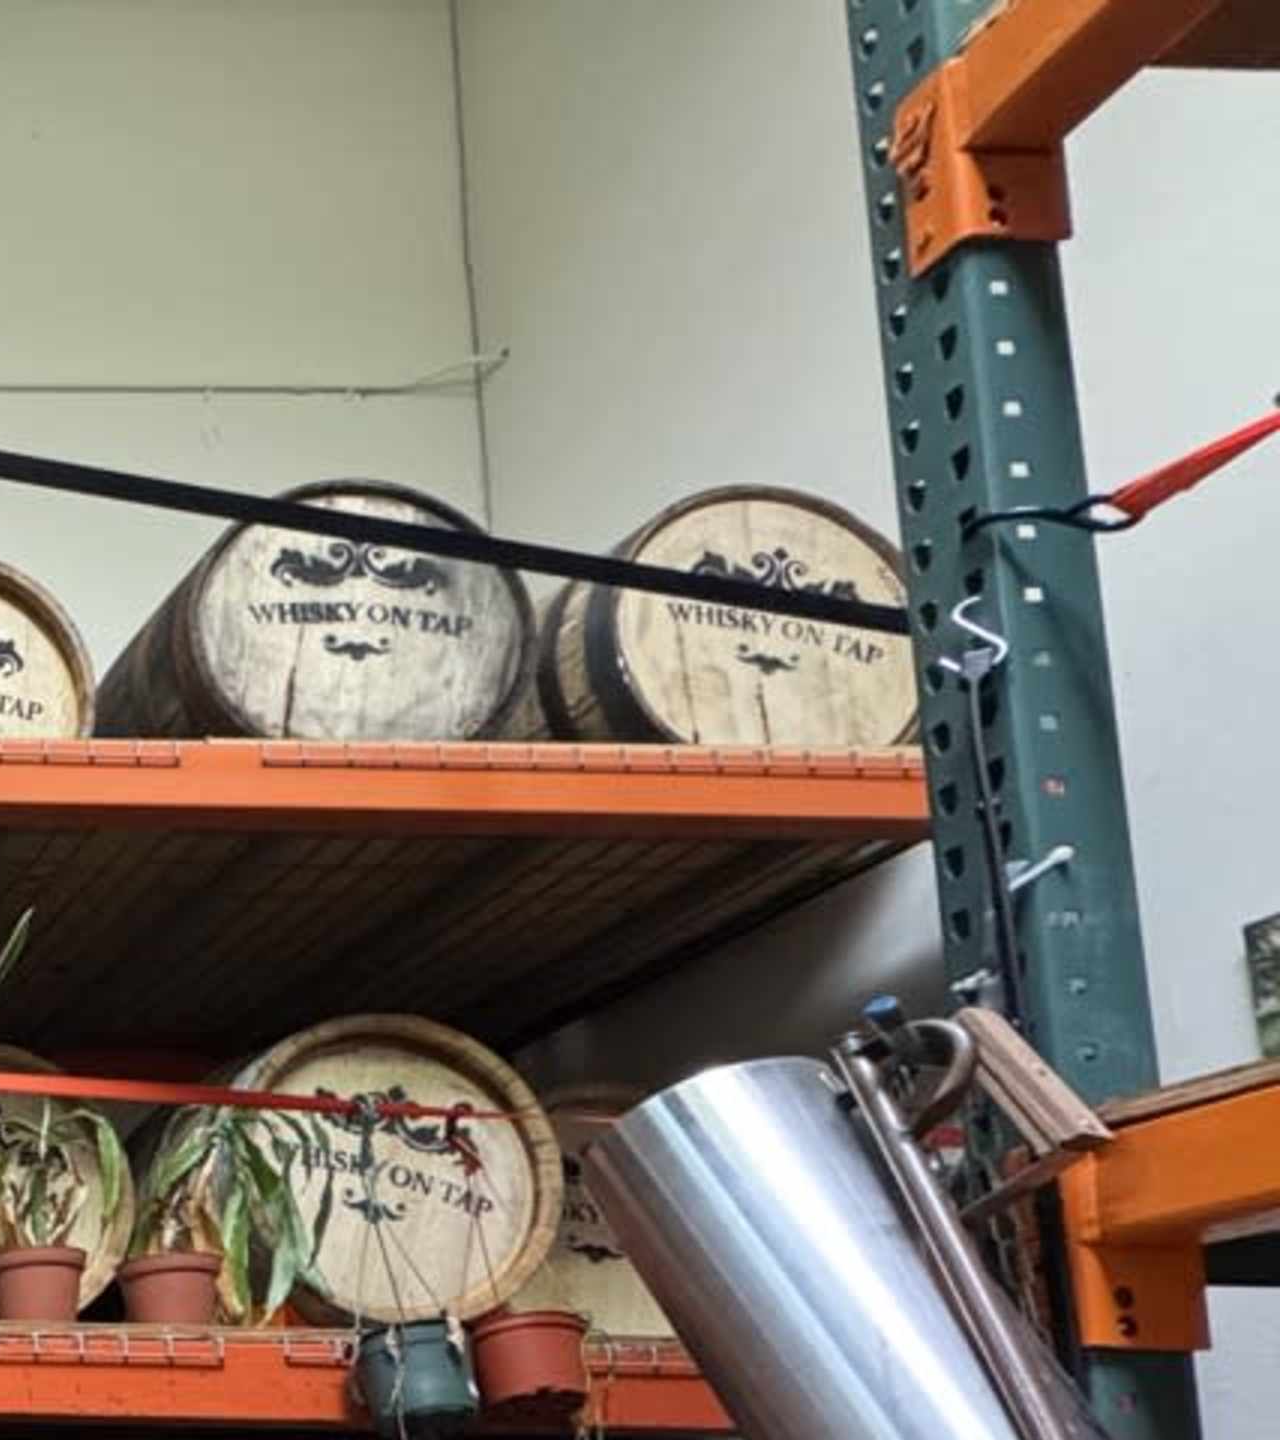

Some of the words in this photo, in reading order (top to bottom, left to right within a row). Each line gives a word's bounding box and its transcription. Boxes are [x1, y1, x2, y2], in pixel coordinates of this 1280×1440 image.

[248, 601, 364, 625] WHISKY
[367, 602, 415, 629] ON
[416, 610, 473, 639] TAP
[666, 602, 779, 640] WHISKY
[780, 620, 827, 649] ON
[830, 635, 885, 665] TAP
[389, 1165, 438, 1197] ON
[438, 1176, 496, 1216] TAP
